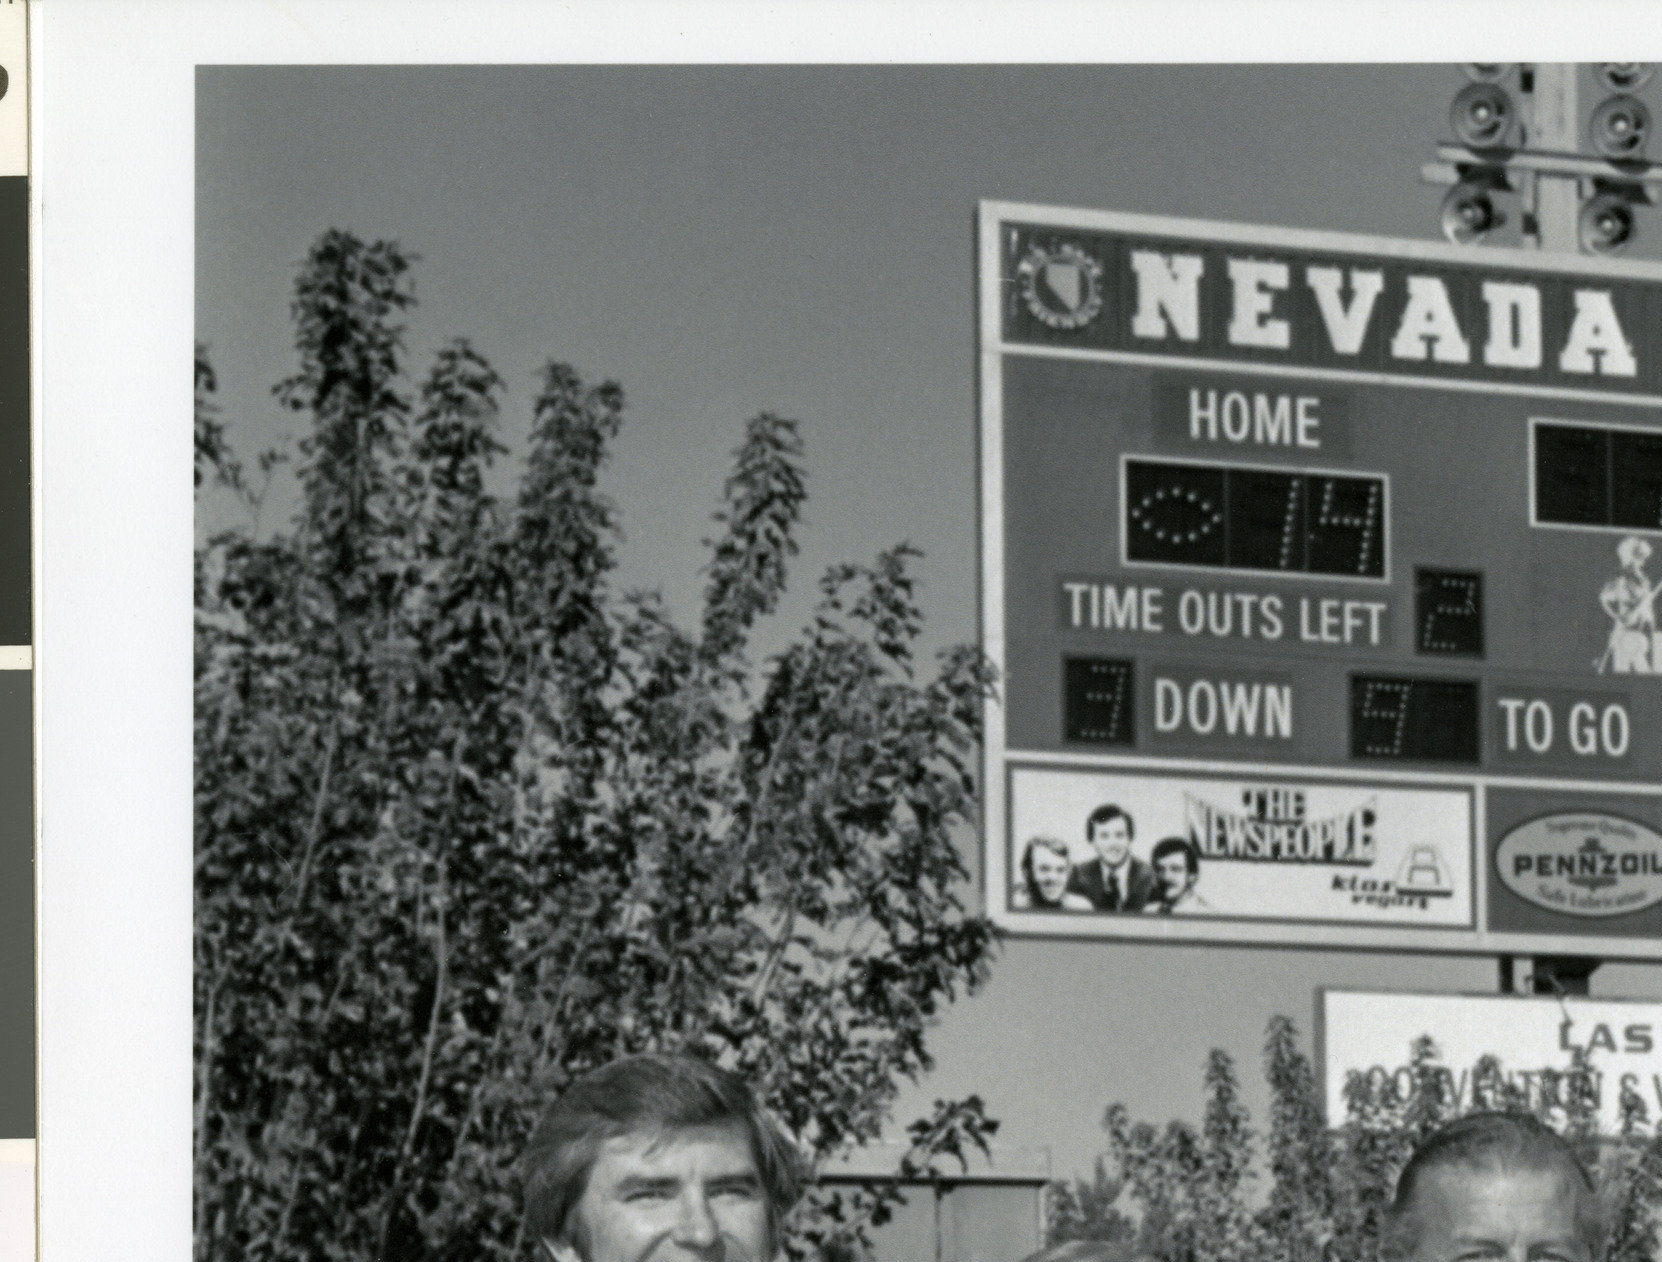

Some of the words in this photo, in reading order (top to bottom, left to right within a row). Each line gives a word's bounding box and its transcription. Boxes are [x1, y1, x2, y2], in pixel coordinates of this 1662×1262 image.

[1131, 249, 1637, 377] NEVADA
[1189, 388, 1321, 448] HOME
[1278, 478, 1380, 574] 14
[1063, 582, 1165, 633] TIME
[1179, 590, 1285, 641] OUTS
[1299, 598, 1388, 646] LEFT
[1423, 577, 1476, 652] 2
[1154, 677, 1293, 740] DOWN
[1362, 682, 1413, 756] 9
[1498, 699, 1553, 753] TO
[1568, 702, 1631, 758] GO
[1184, 791, 1378, 862] NEWSPEOPLE
[1242, 787, 1305, 823] THE
[1559, 1021, 1654, 1053] LAS
